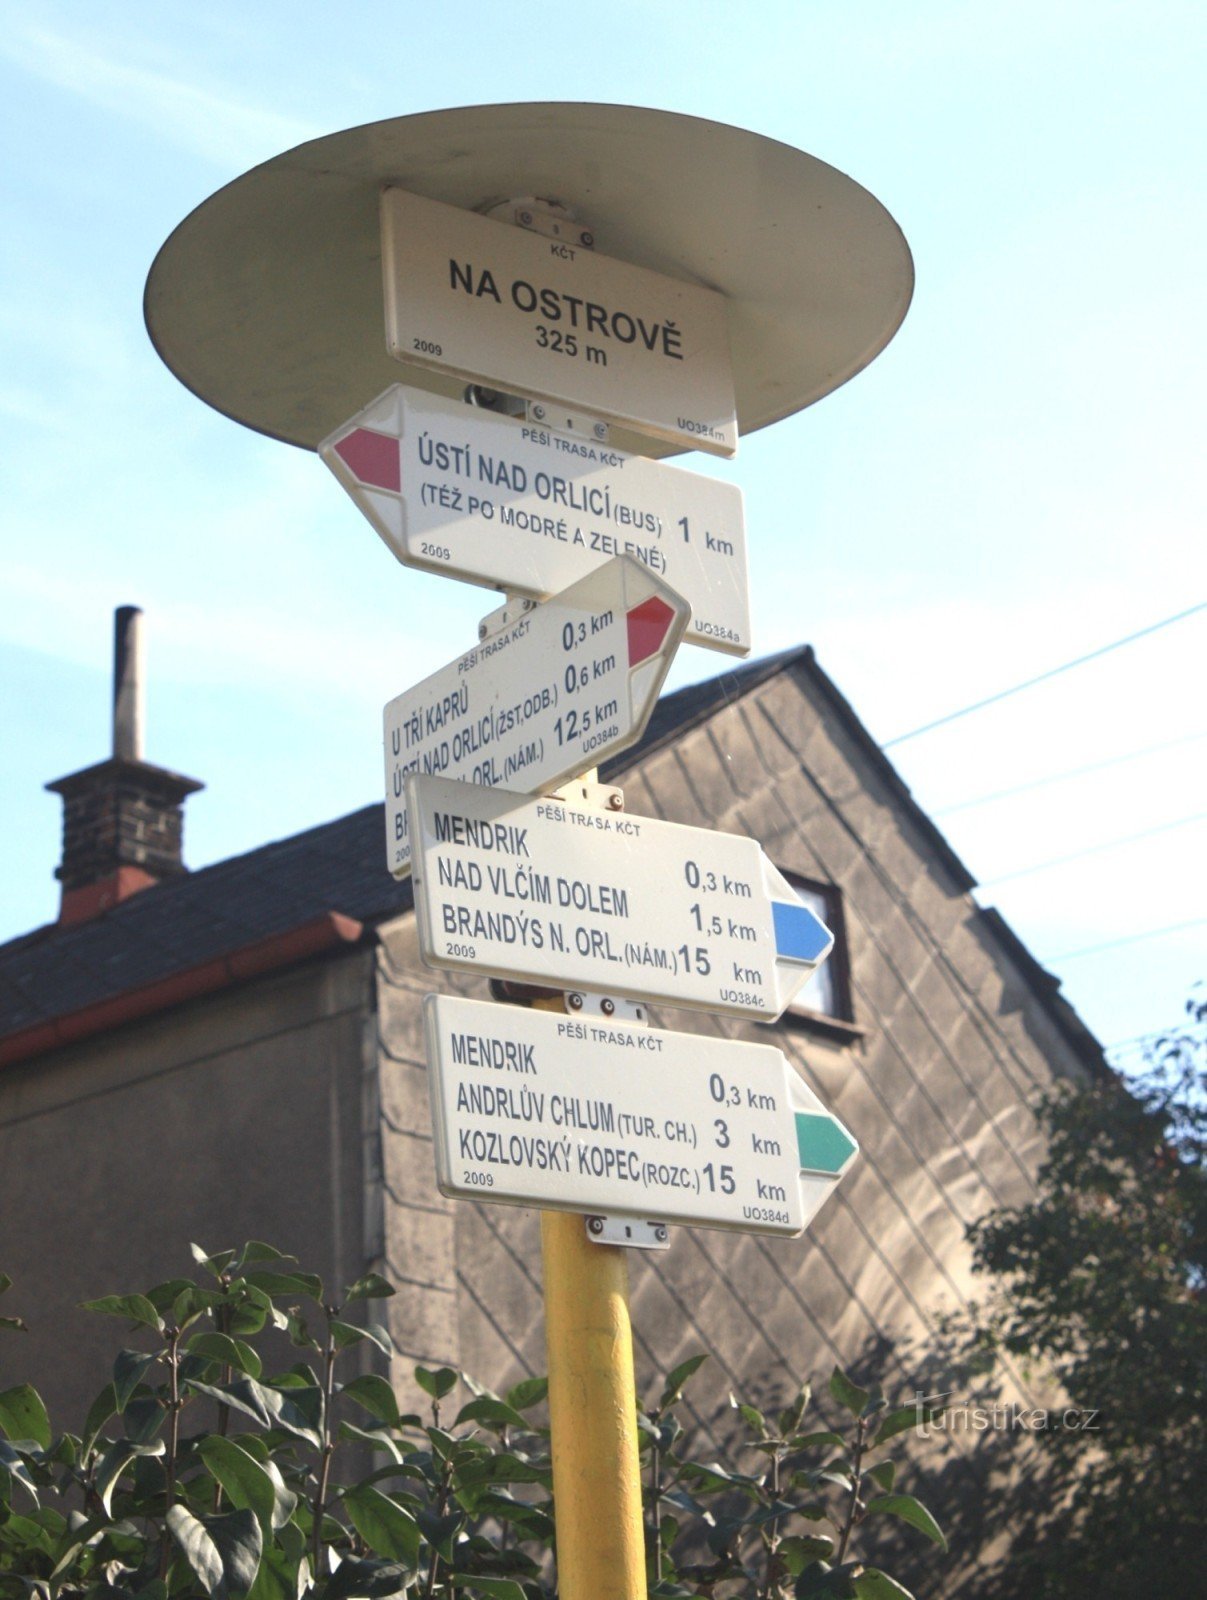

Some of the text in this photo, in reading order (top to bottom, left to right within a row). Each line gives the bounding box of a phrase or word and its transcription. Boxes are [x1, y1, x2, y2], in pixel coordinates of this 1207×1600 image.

[550, 243, 576, 261] KČT
[449, 259, 683, 360] NA OSTROVĚ
[413, 338, 443, 356] 2009
[535, 325, 607, 366] 325 m
[677, 417, 725, 441] UO384m
[554, 438, 597, 461] TRASA
[600, 451, 625, 468] KČT
[418, 432, 734, 556] ÚSTÍ NAD ORLICÍ (BUS) 1 km
[421, 482, 666, 575] (TÉŽ PO MODRÉ A ZELENÉ)
[421, 541, 451, 560] 2009
[480, 634, 510, 661] TRASA
[512, 620, 531, 642] KČT
[695, 619, 740, 642] UO384a
[391, 610, 614, 756] U TŘÍ KAPRŮ 0,3 km
[423, 741, 449, 776] NAD
[452, 706, 494, 763] ORLICÍ
[564, 664, 589, 695] 0,6
[592, 653, 616, 679] km
[503, 737, 544, 782] (NÁM.)
[553, 709, 591, 746] 12,5
[594, 698, 618, 725] km
[582, 725, 619, 753] UO384b
[536, 805, 641, 837] PĚŠÍ TRASA KČT
[395, 844, 411, 863] 200
[434, 811, 530, 857] MENDRIK
[684, 860, 717, 893] 0,3
[722, 874, 752, 898] km
[438, 856, 757, 942] NAD VLČÍM DOLEM 1,5 km
[442, 903, 762, 986] BRANDÝS N. ORL. (NÁM.) 15 km
[446, 942, 476, 959] 2009
[719, 988, 765, 1008] UO384c
[557, 1022, 664, 1052] PĚŠÍ TRASA KČT
[451, 1033, 776, 1112] MENDRIK 0,3 km
[457, 1082, 781, 1157] ANDRLŮV CHLUM (TUR. CH.) 3 km
[458, 1128, 786, 1202] KOZLOVSKÝ KOPEC (ROZC.) 15 km
[463, 1170, 494, 1187] 2009
[743, 1205, 790, 1224] UO384d
